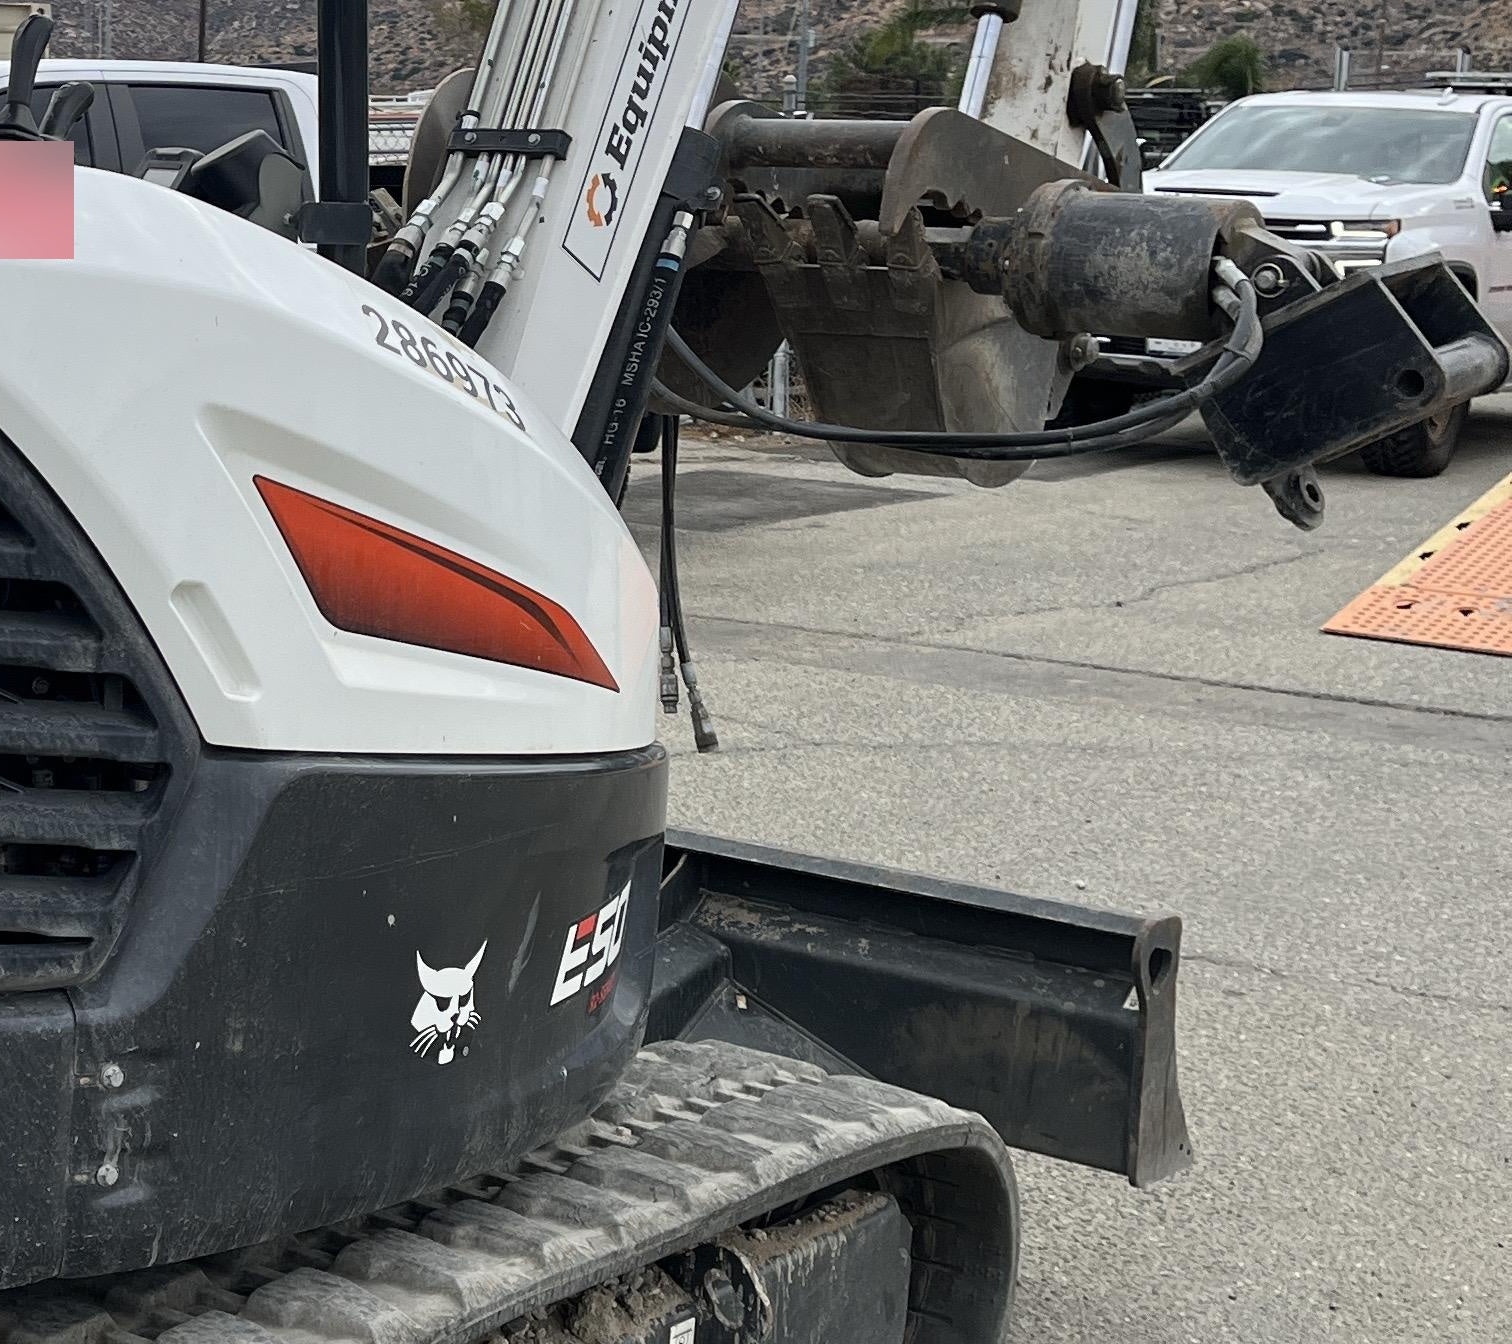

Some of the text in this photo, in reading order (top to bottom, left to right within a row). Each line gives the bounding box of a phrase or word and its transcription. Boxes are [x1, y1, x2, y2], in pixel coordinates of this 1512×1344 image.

[361, 304, 527, 432] 286973
[620, 340, 647, 387] MSHA
[549, 879, 632, 1007] E50
